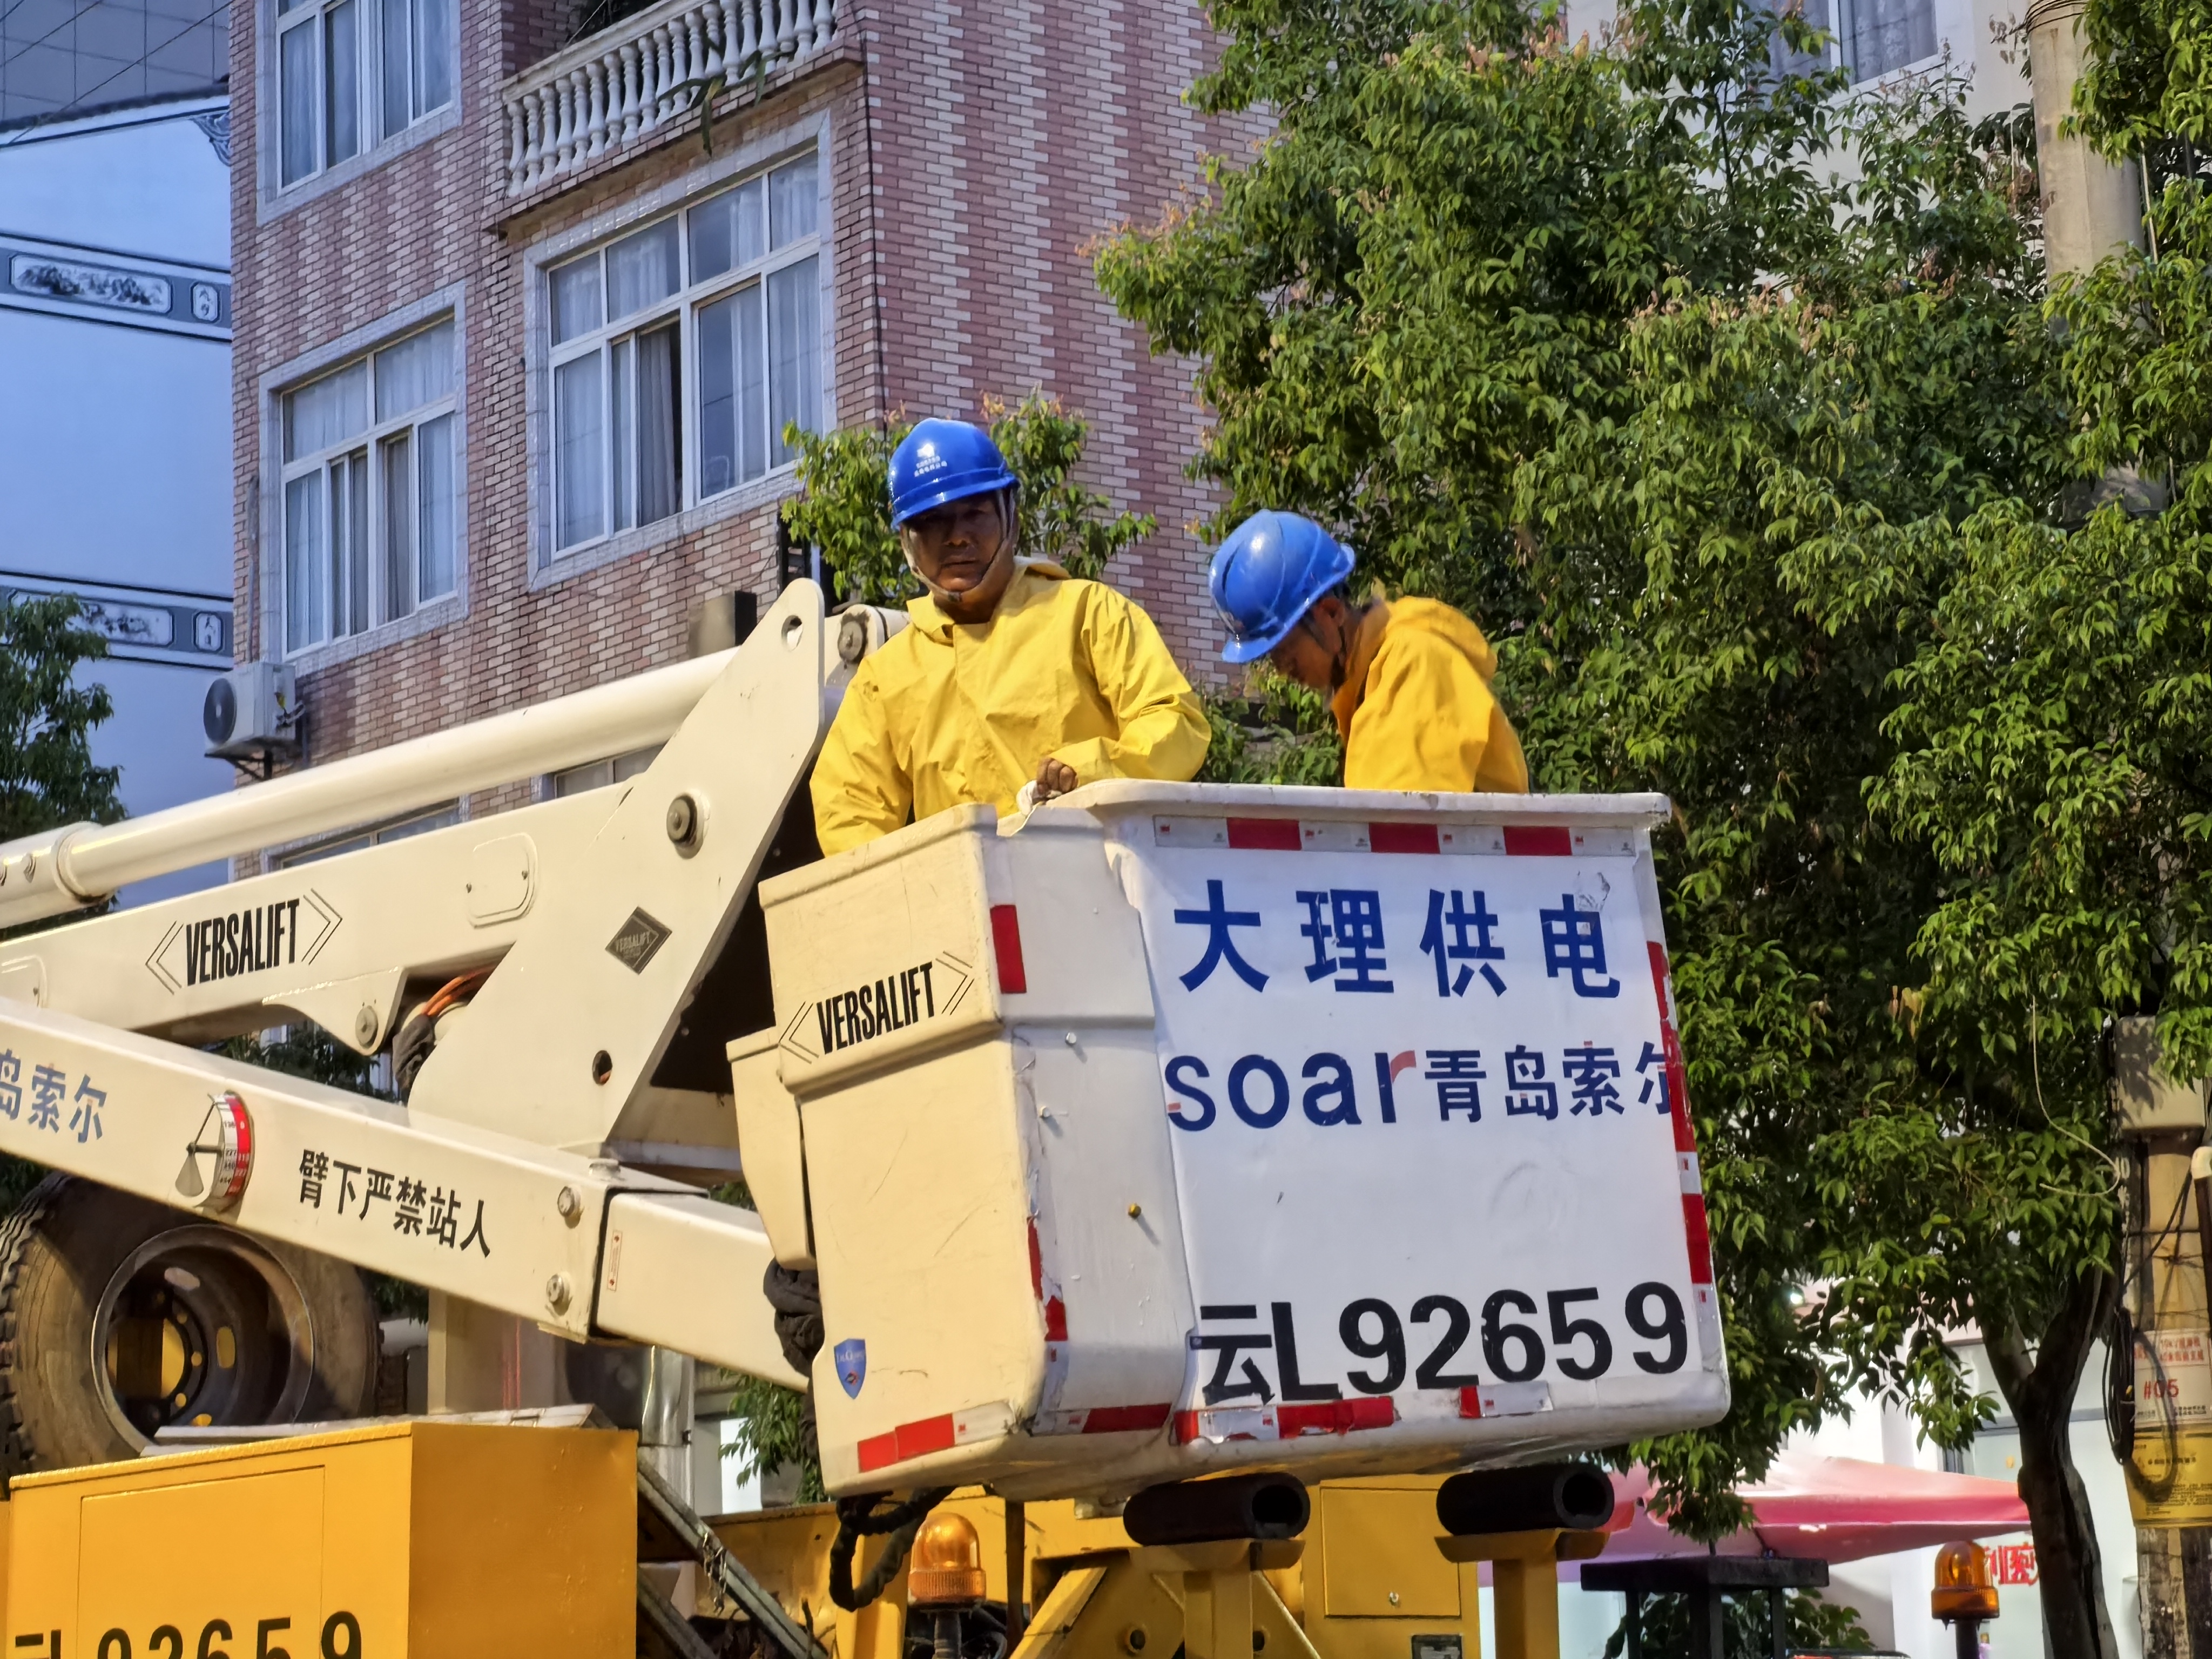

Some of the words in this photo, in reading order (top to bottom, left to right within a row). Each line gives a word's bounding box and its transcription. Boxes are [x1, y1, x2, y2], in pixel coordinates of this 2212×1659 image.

[186, 899, 300, 986] VERSALIFT
[1174, 880, 1620, 997] 大理供电
[817, 962, 934, 1055] VERSALIFT
[300, 1149, 491, 1258] 臂下严禁站人
[1190, 1282, 1687, 1404] 云L92659
